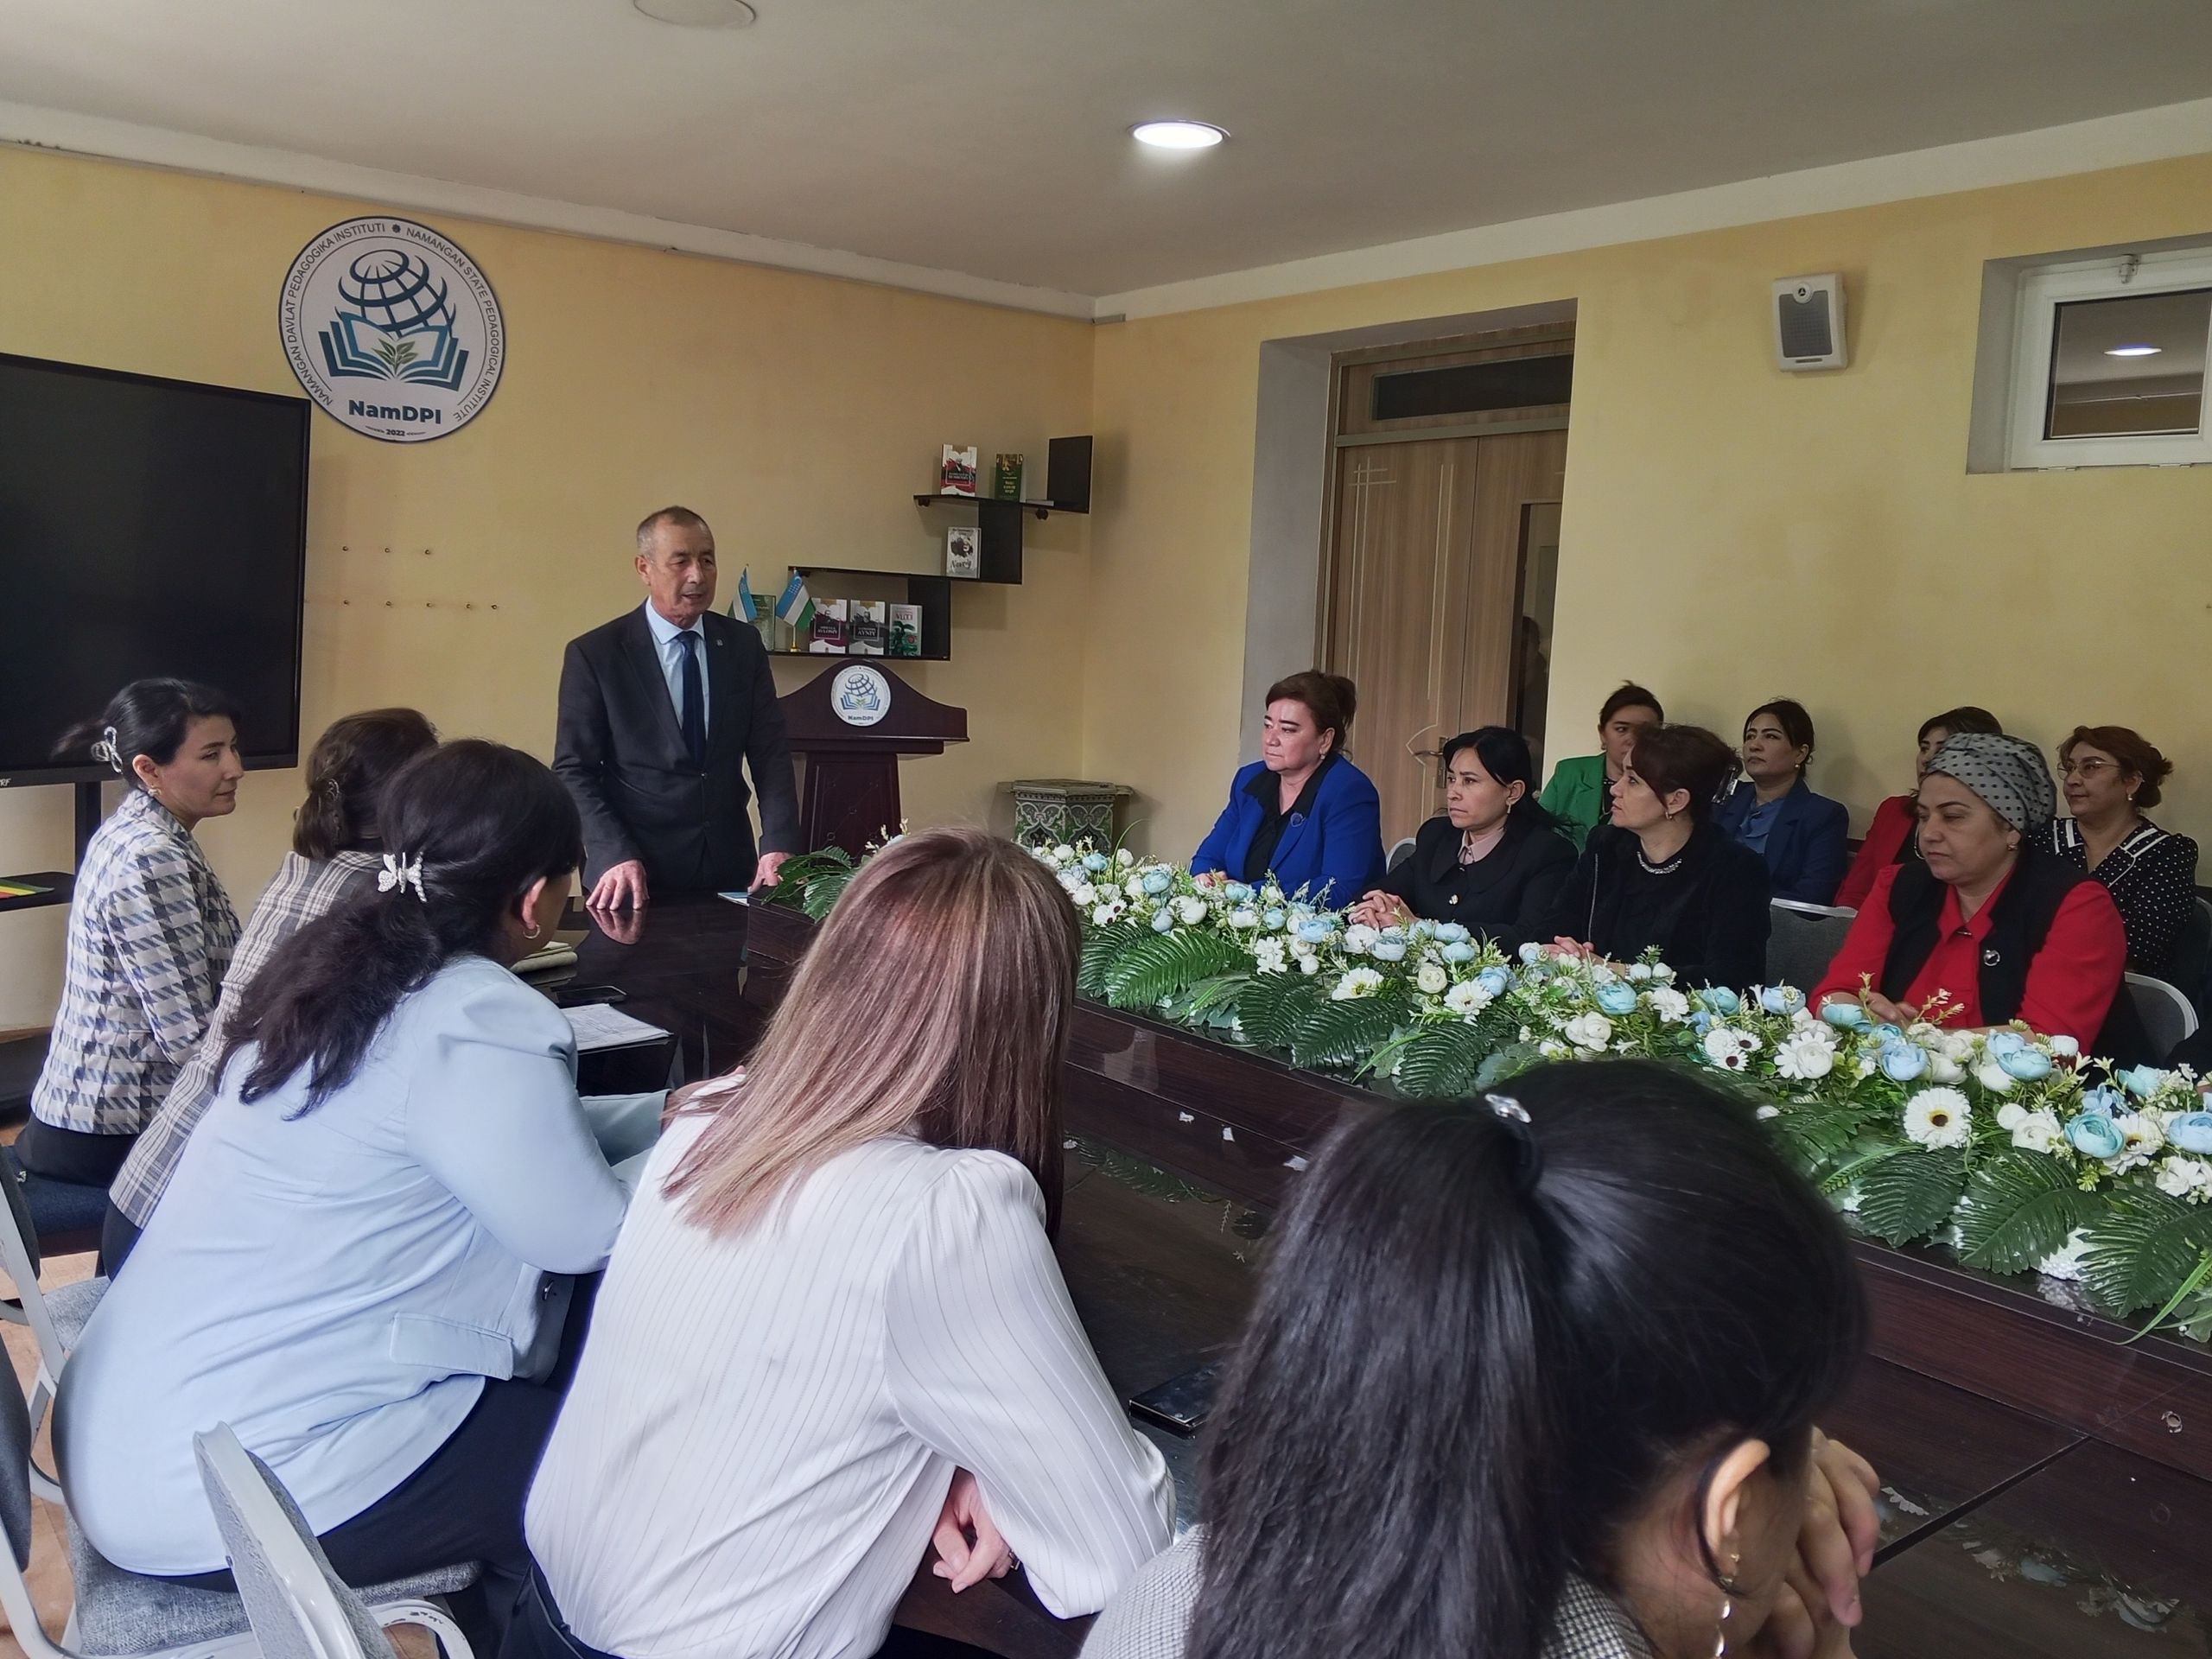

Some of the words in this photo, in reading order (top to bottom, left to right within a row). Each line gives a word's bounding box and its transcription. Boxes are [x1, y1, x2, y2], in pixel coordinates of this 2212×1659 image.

[333, 223, 385, 243] INSTITUTI
[406, 227, 466, 268] NAMANGAN
[288, 238, 334, 298] PEDAGOGIKA
[463, 266, 488, 299] STATE
[284, 299, 297, 343] DAVLAT
[483, 299, 499, 376] PEDAGOGICAL
[289, 346, 333, 405] NAMANGAN
[348, 399, 442, 424] NamDPI
[453, 378, 492, 422] INSTITUTE
